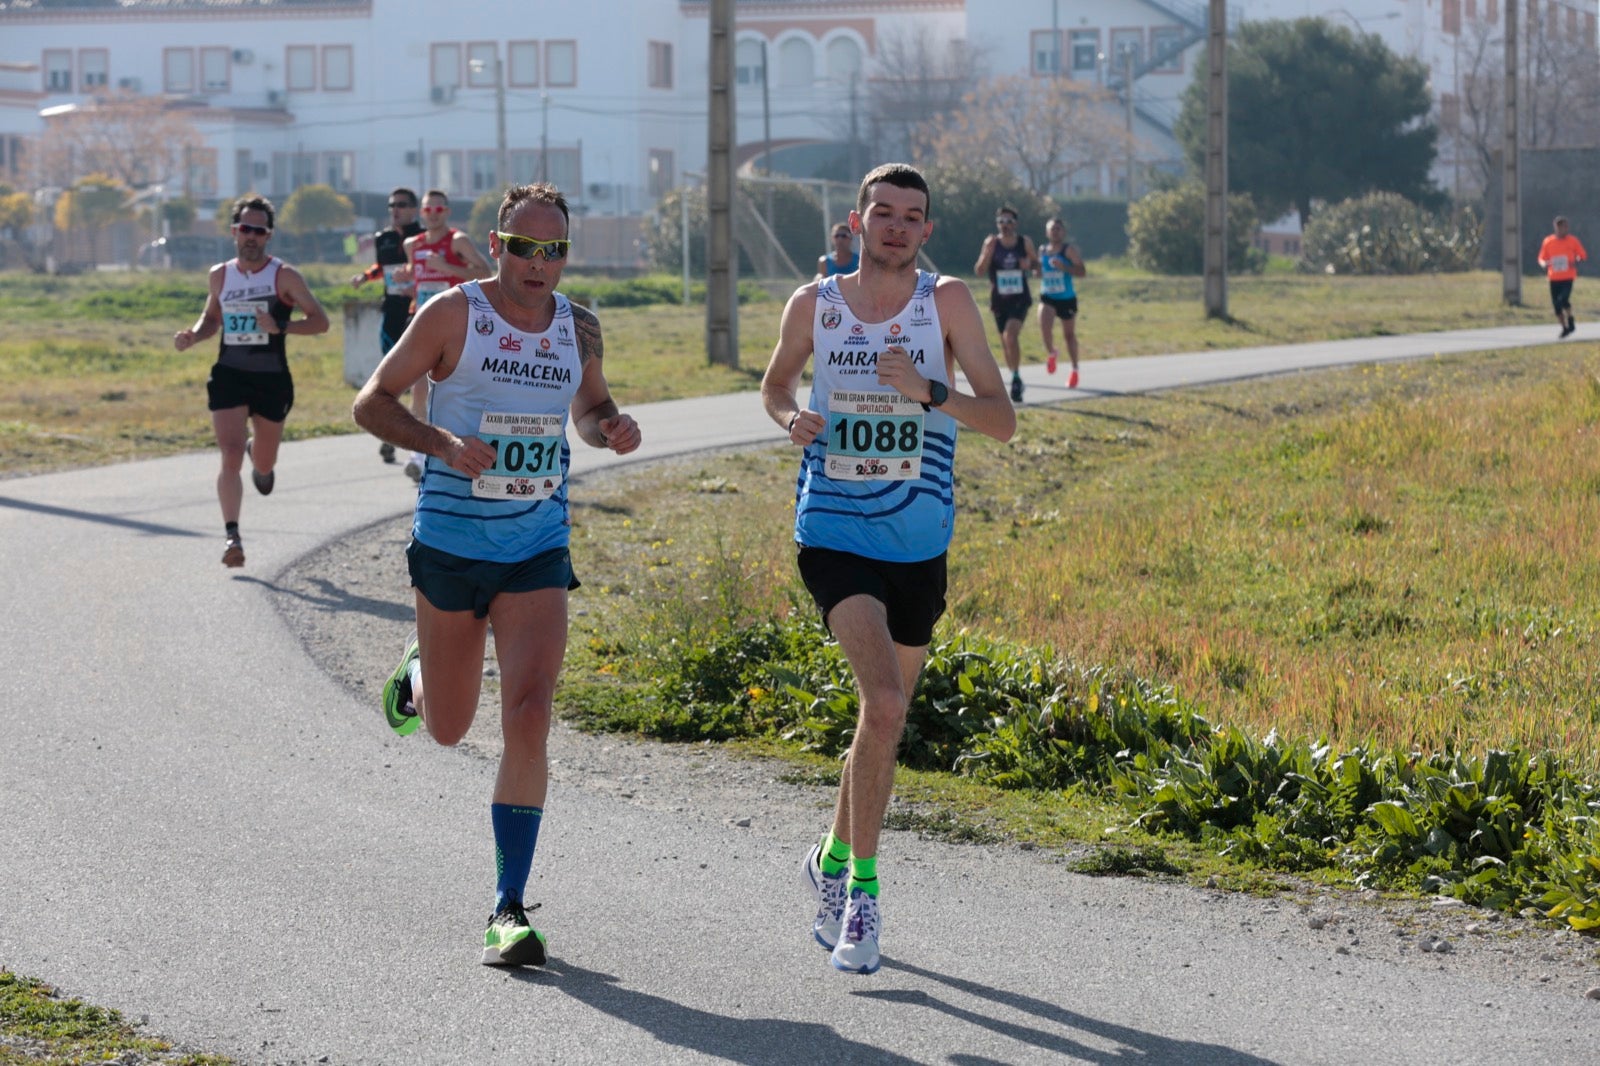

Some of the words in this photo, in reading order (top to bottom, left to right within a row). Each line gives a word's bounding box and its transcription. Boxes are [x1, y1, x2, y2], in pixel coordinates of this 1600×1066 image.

[229, 315, 257, 331] 377
[828, 349, 925, 367] MARAA
[481, 357, 571, 383] MARACENA
[493, 375, 512, 384] CLUB
[848, 393, 865, 403] GRAN
[866, 394, 890, 404] PREMIO
[890, 395, 899, 404] DE
[856, 404, 894, 414] DIPUTACIÓN
[503, 416, 519, 425] GRAN
[520, 416, 542, 425] PREMIO
[542, 417, 550, 426] DE
[835, 418, 919, 452] 1088
[489, 439, 558, 473] 1031
